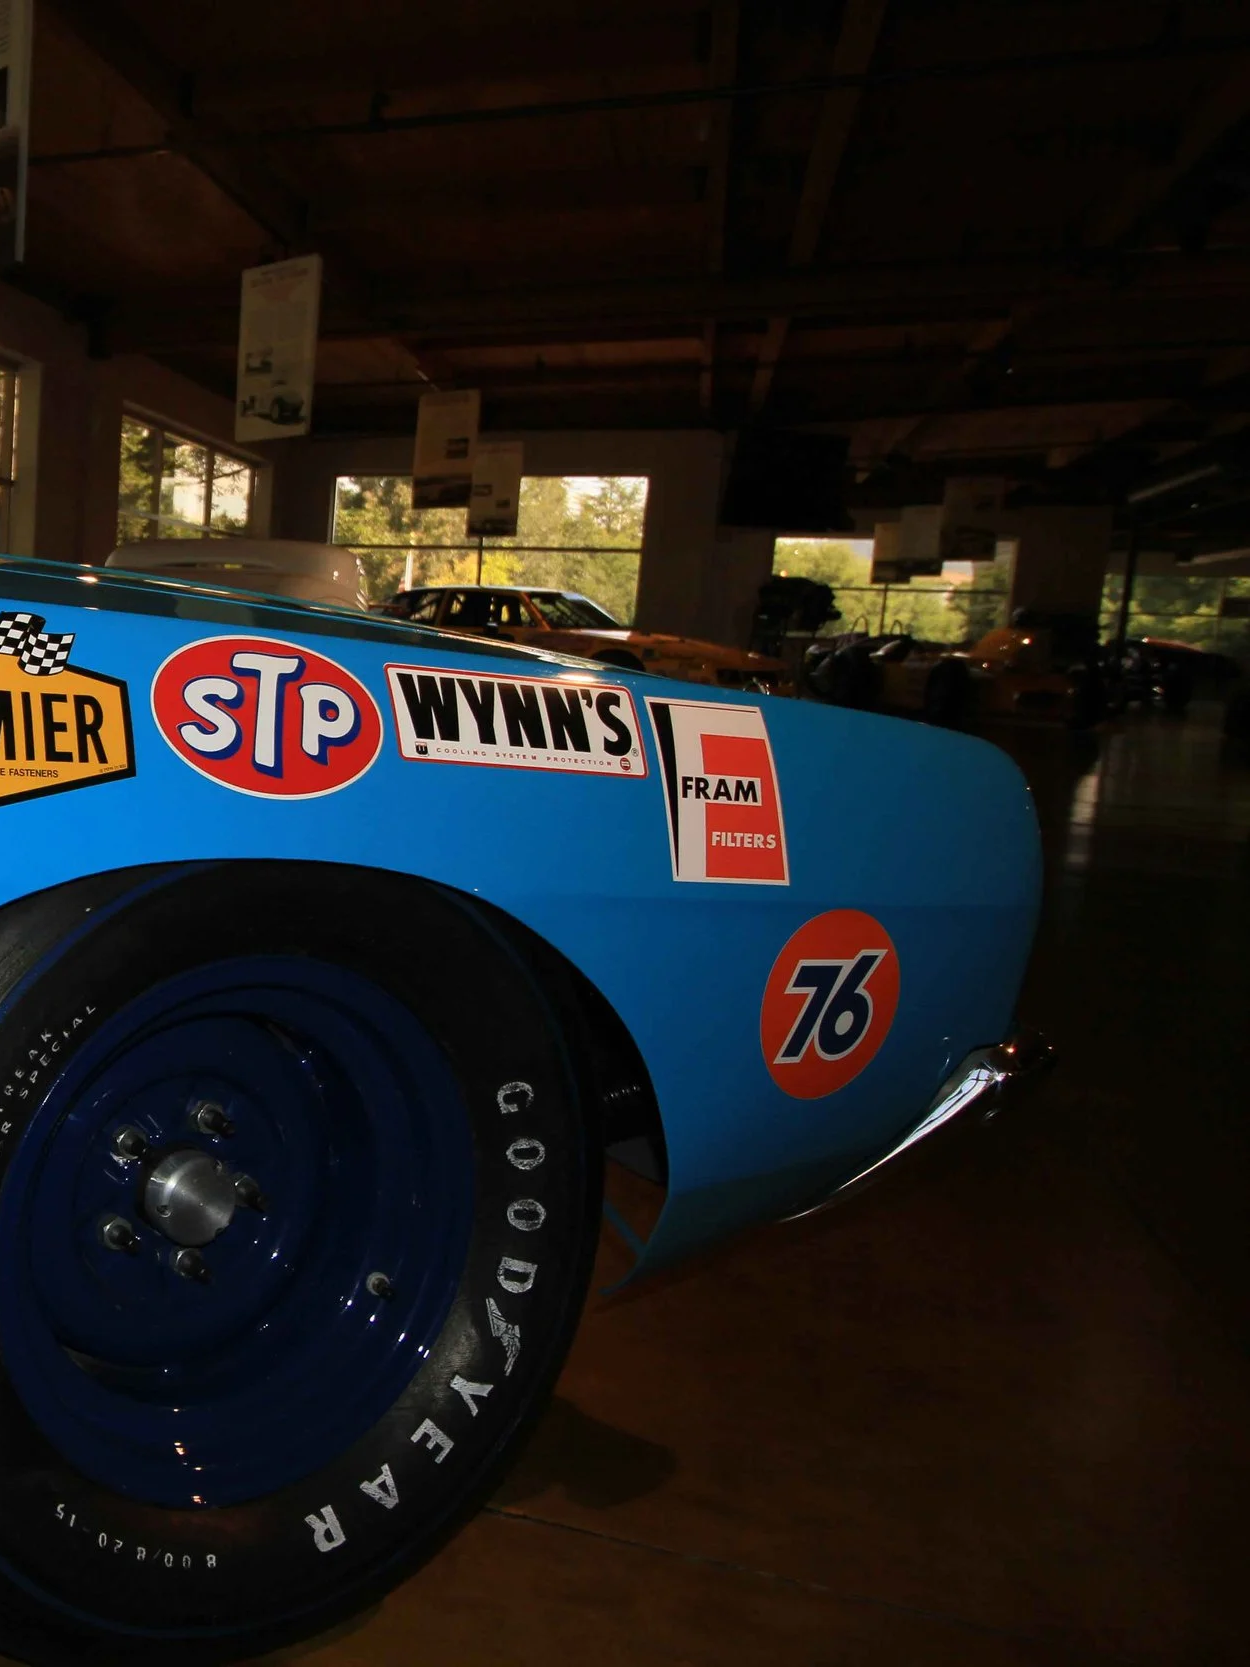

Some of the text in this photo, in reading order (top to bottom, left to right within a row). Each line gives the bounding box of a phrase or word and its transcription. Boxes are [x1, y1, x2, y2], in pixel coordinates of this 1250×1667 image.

[176, 650, 362, 779] STP
[396, 672, 633, 757] WYNN'S
[8, 768, 59, 779] FASTENERS
[436, 747, 613, 766] COOLING SYSTEM PROTECTION
[681, 775, 759, 803] FRAM
[711, 831, 777, 849] FILTERS
[773, 949, 888, 1064] 76
[19, 1004, 96, 1100] SPECIAL
